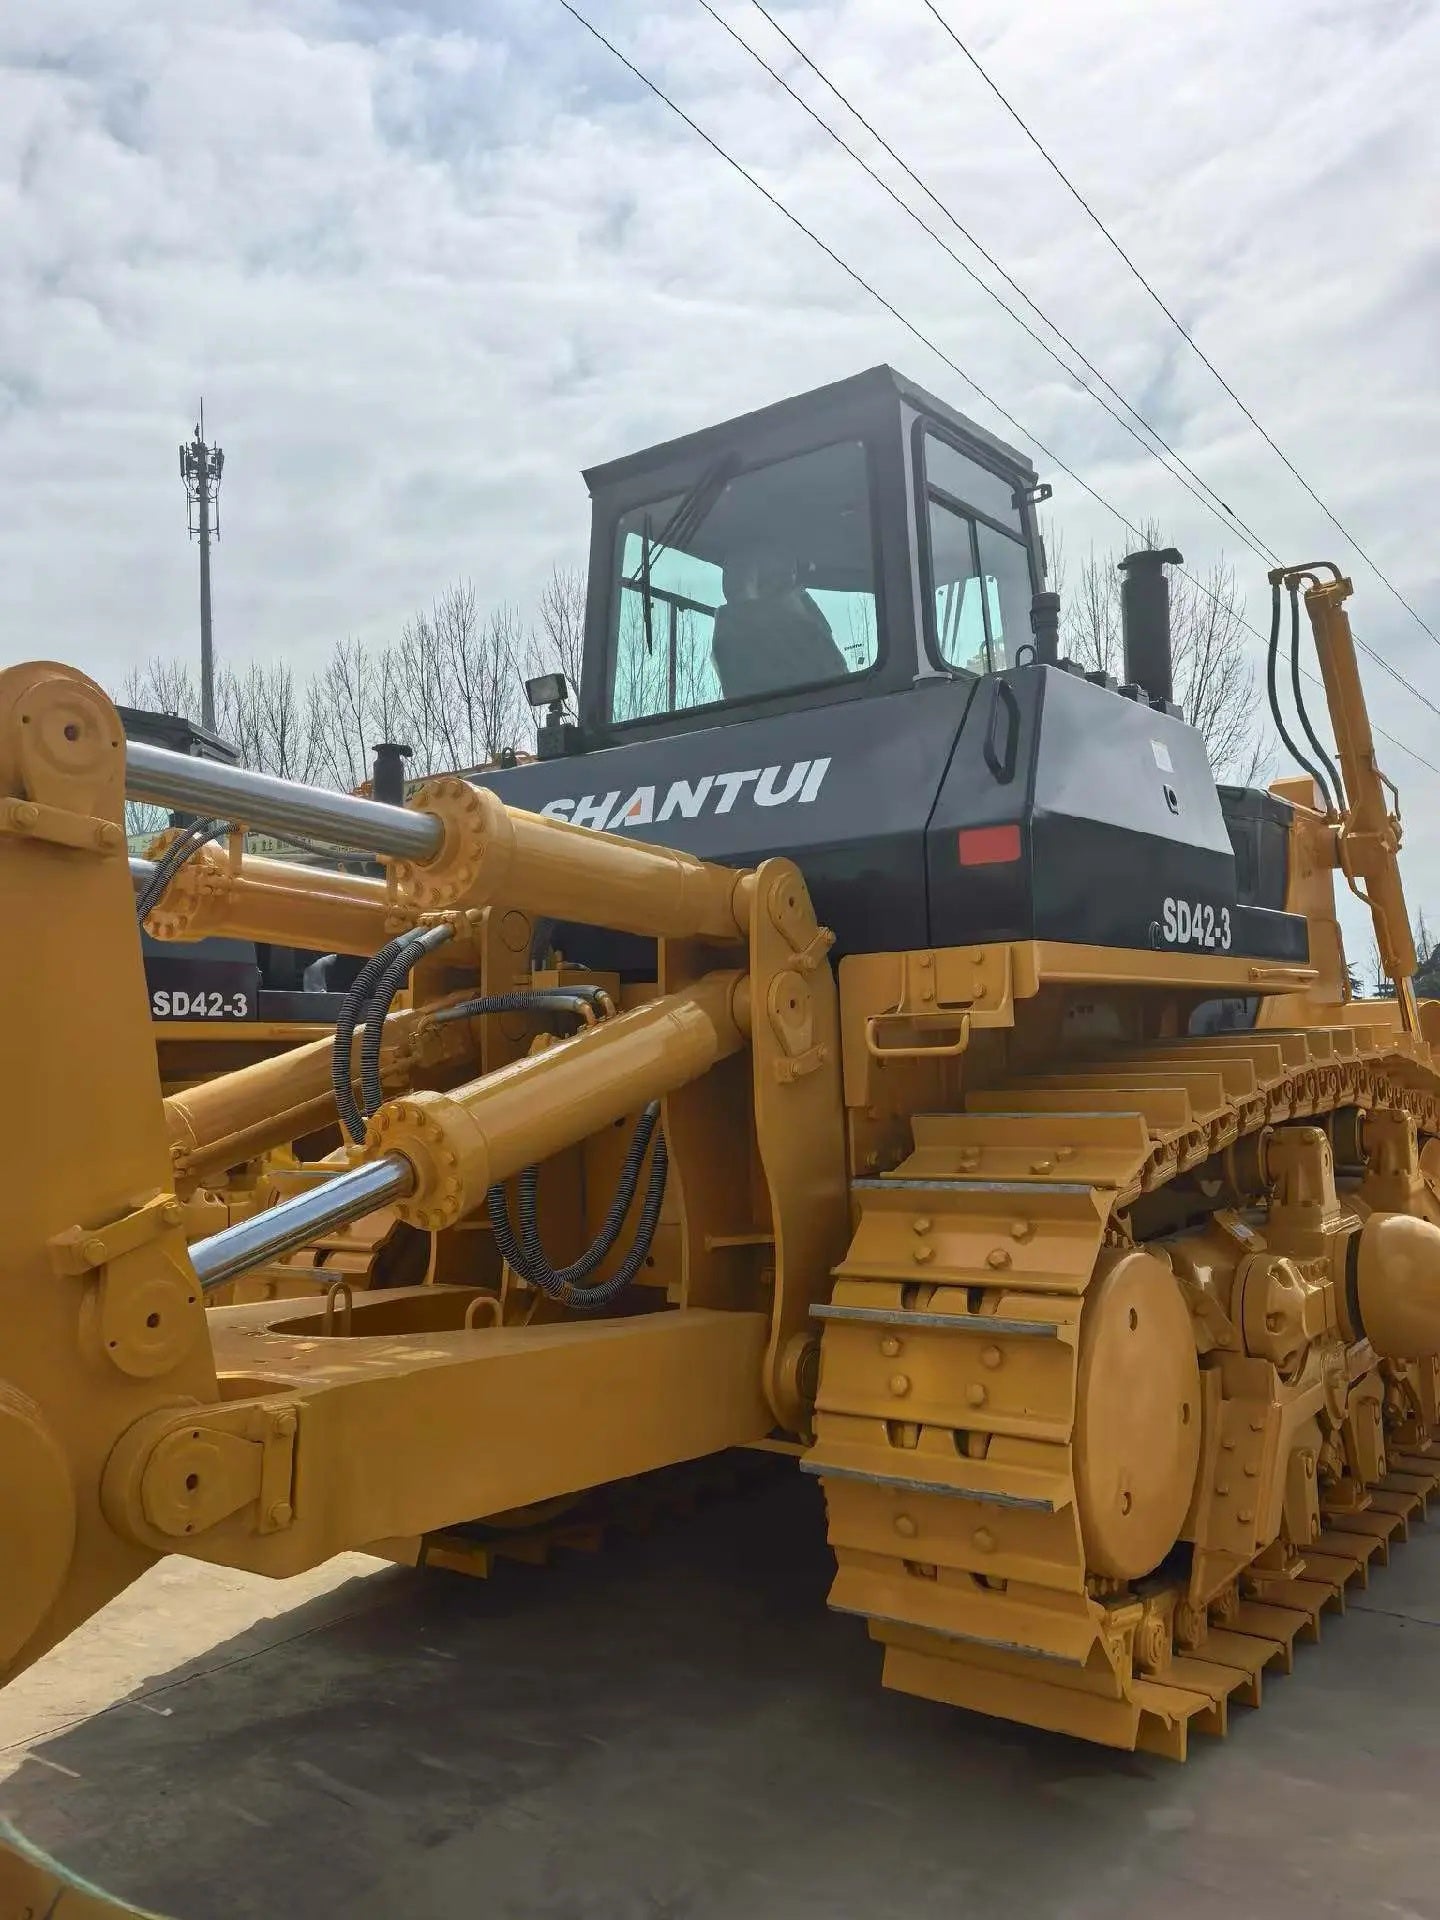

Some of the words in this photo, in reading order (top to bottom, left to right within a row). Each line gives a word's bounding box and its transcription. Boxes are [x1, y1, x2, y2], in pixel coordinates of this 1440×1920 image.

[539, 757, 832, 831] SHANTUI
[1162, 897, 1232, 950] SD42-3
[152, 990, 248, 1017] SD42-3
